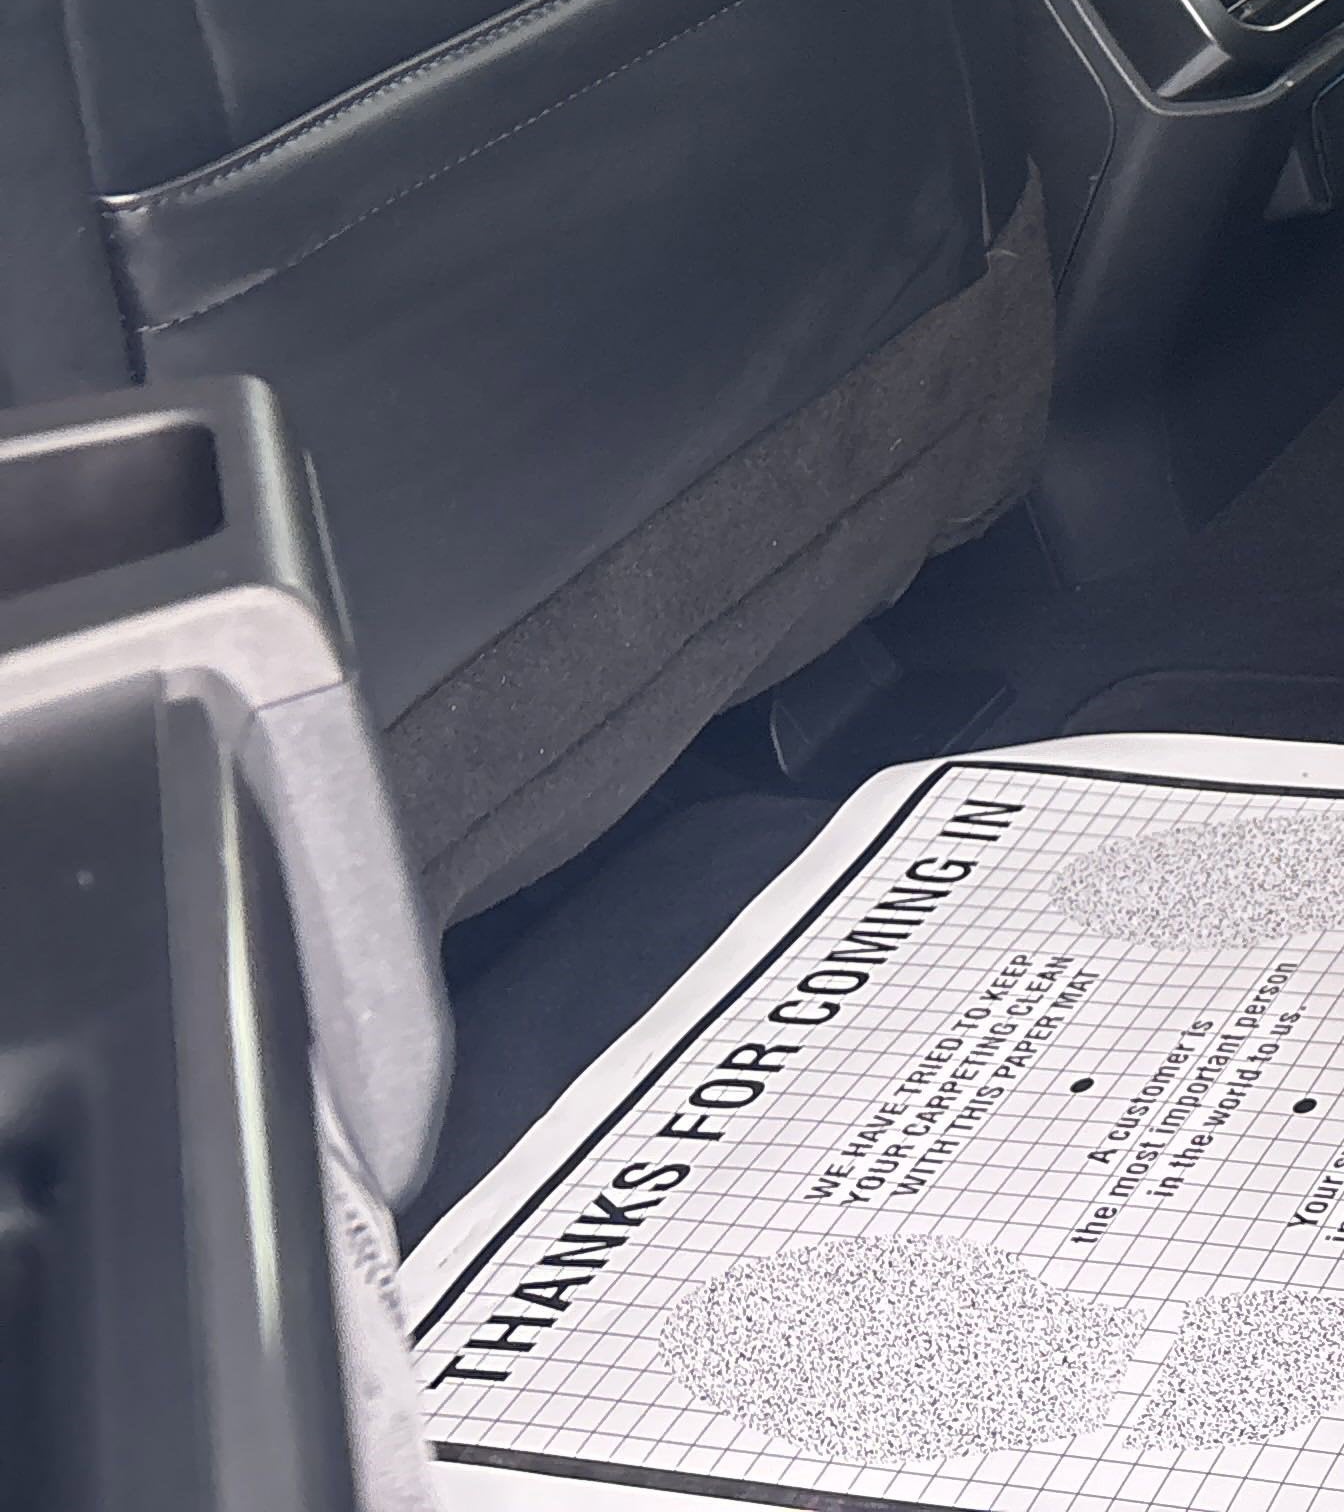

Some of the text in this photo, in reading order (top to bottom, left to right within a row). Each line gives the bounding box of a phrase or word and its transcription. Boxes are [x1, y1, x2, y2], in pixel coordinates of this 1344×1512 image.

[425, 799, 1026, 1390] THANKS FOR COMING IN
[804, 954, 1032, 1200] WE HAVE TRIED TO KEEP
[840, 956, 1074, 1206] YOUR CARPETING CLEAN
[890, 968, 1100, 1197] WITH THIS PAPER MAT
[1071, 962, 1298, 1243] the most important person
[1087, 1020, 1214, 1164] A customer is
[1146, 1005, 1307, 1197] in the world to us.
[1287, 1176, 1344, 1228] Your
